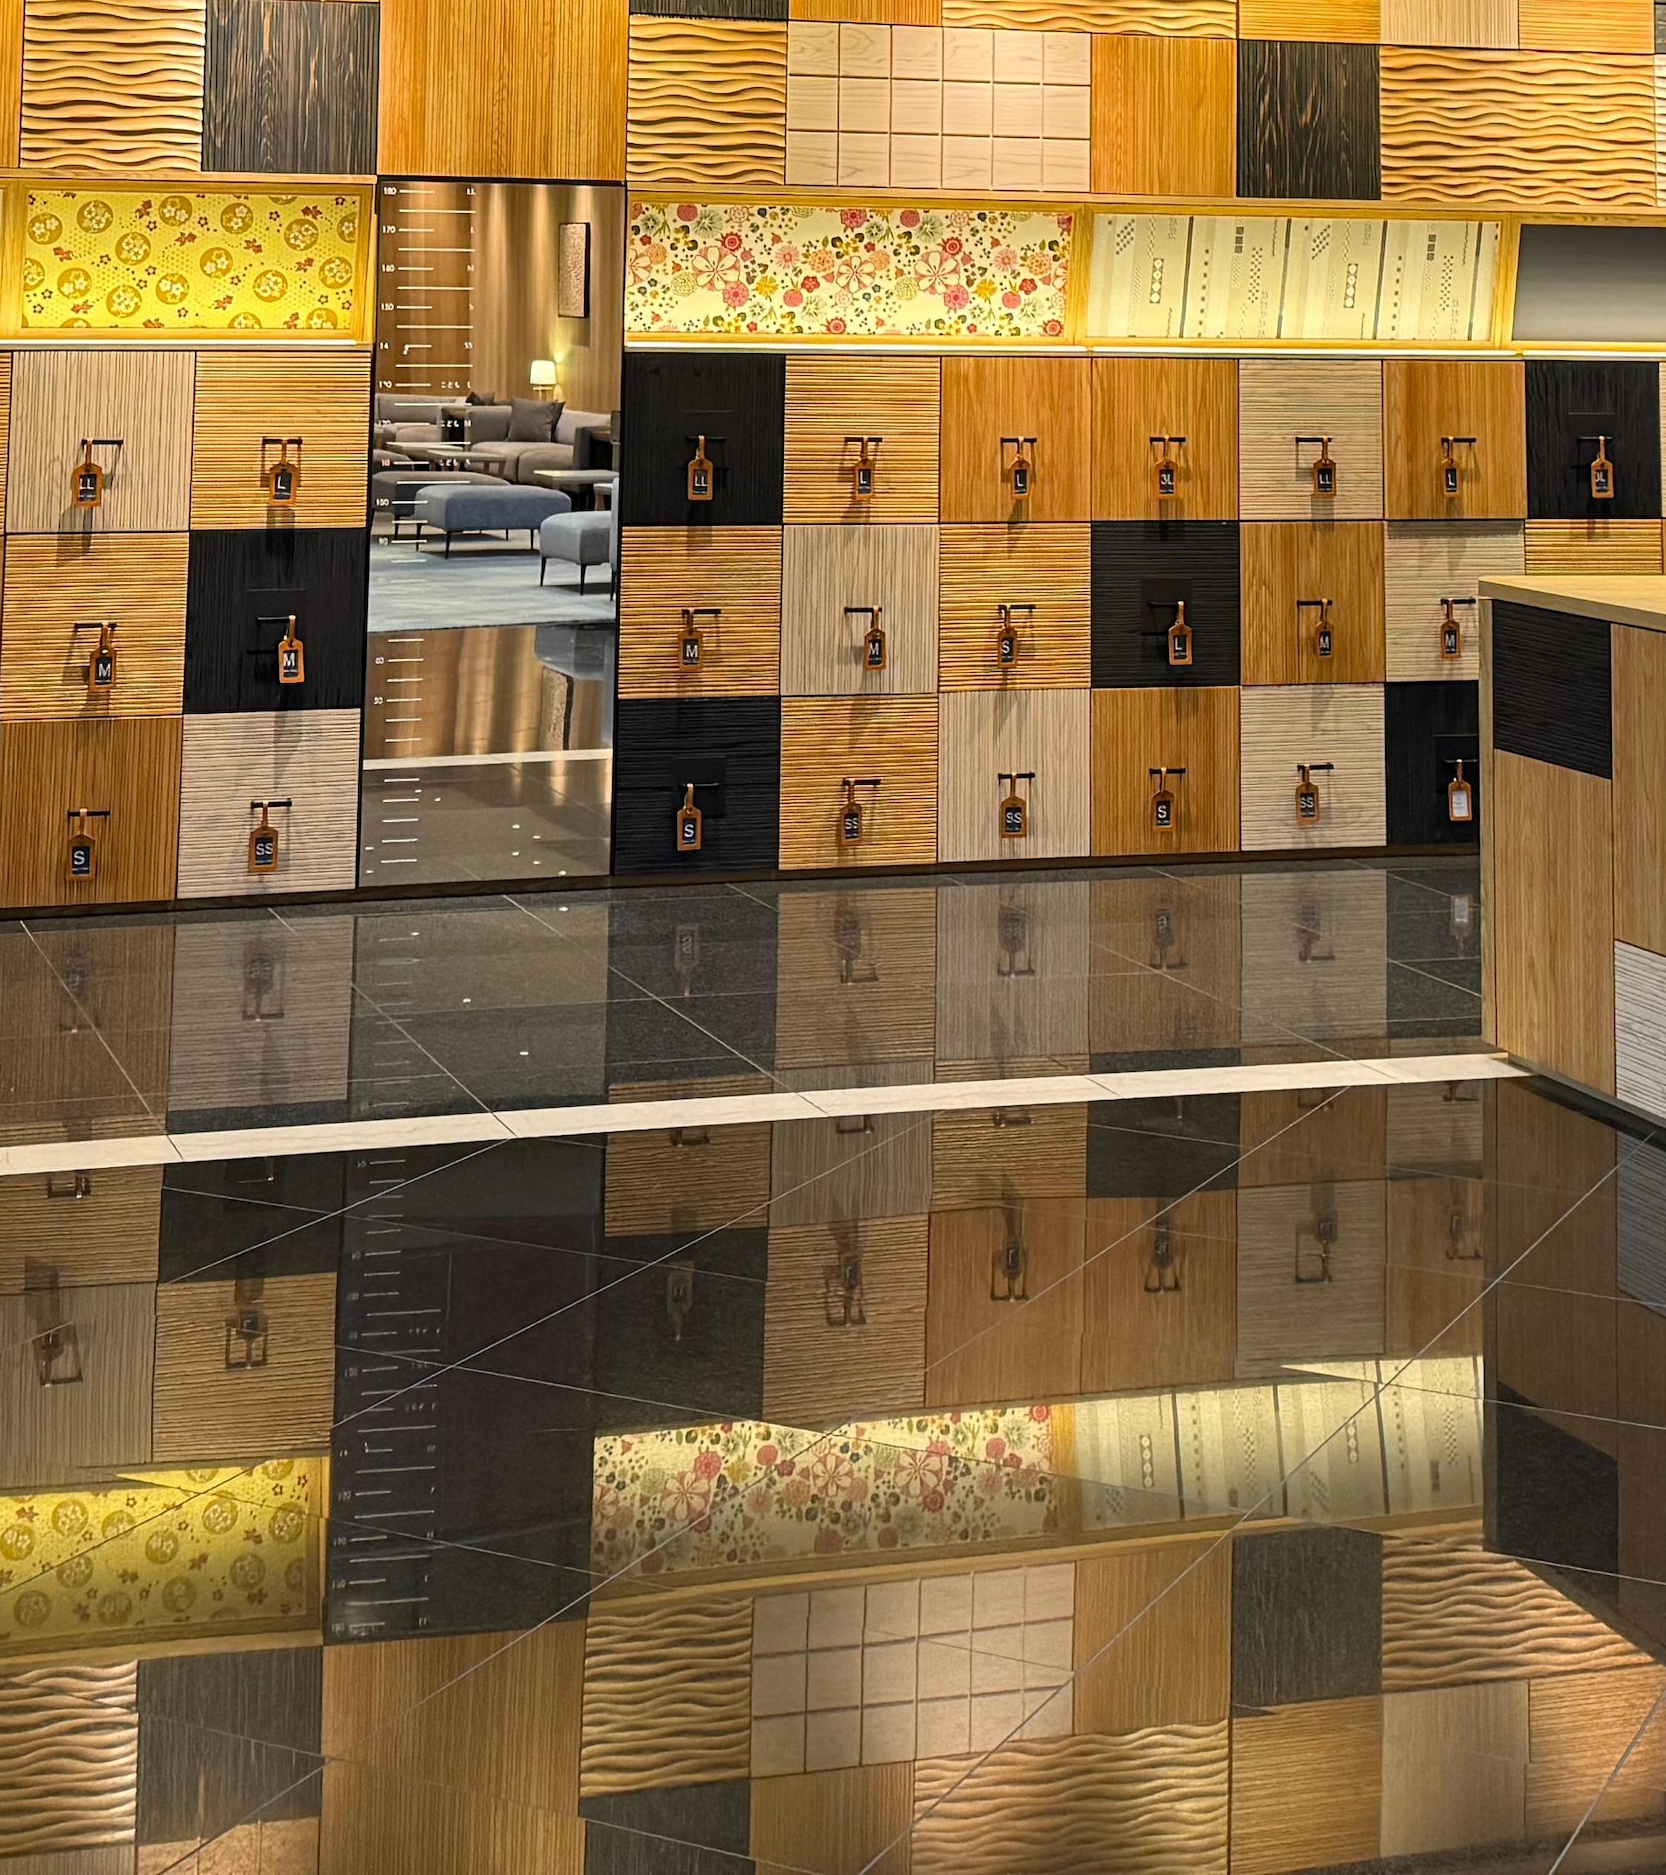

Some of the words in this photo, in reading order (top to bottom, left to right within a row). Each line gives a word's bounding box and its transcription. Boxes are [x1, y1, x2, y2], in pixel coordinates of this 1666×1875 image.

[382, 225, 396, 234] 170
[79, 478, 95, 490] LL
[277, 476, 286, 489] L
[695, 475, 707, 486] LL
[860, 471, 867, 484] L
[1017, 474, 1024, 486] L
[1161, 474, 1173, 485] 3L
[1319, 474, 1331, 484] LL
[1448, 473, 1455, 485] L
[1175, 637, 1183, 650] L
[1445, 633, 1455, 647] M
[686, 644, 698, 658] M
[870, 642, 879, 655] M
[1002, 640, 1010, 654] S
[283, 652, 295, 667] M
[98, 663, 110, 677] M
[1300, 796, 1313, 808] SS
[1005, 812, 1022, 823] SS
[1157, 805, 1167, 818] S
[845, 817, 859, 829] SS
[684, 824, 694, 837] S
[256, 843, 273, 855] SS
[74, 851, 85, 865] S
